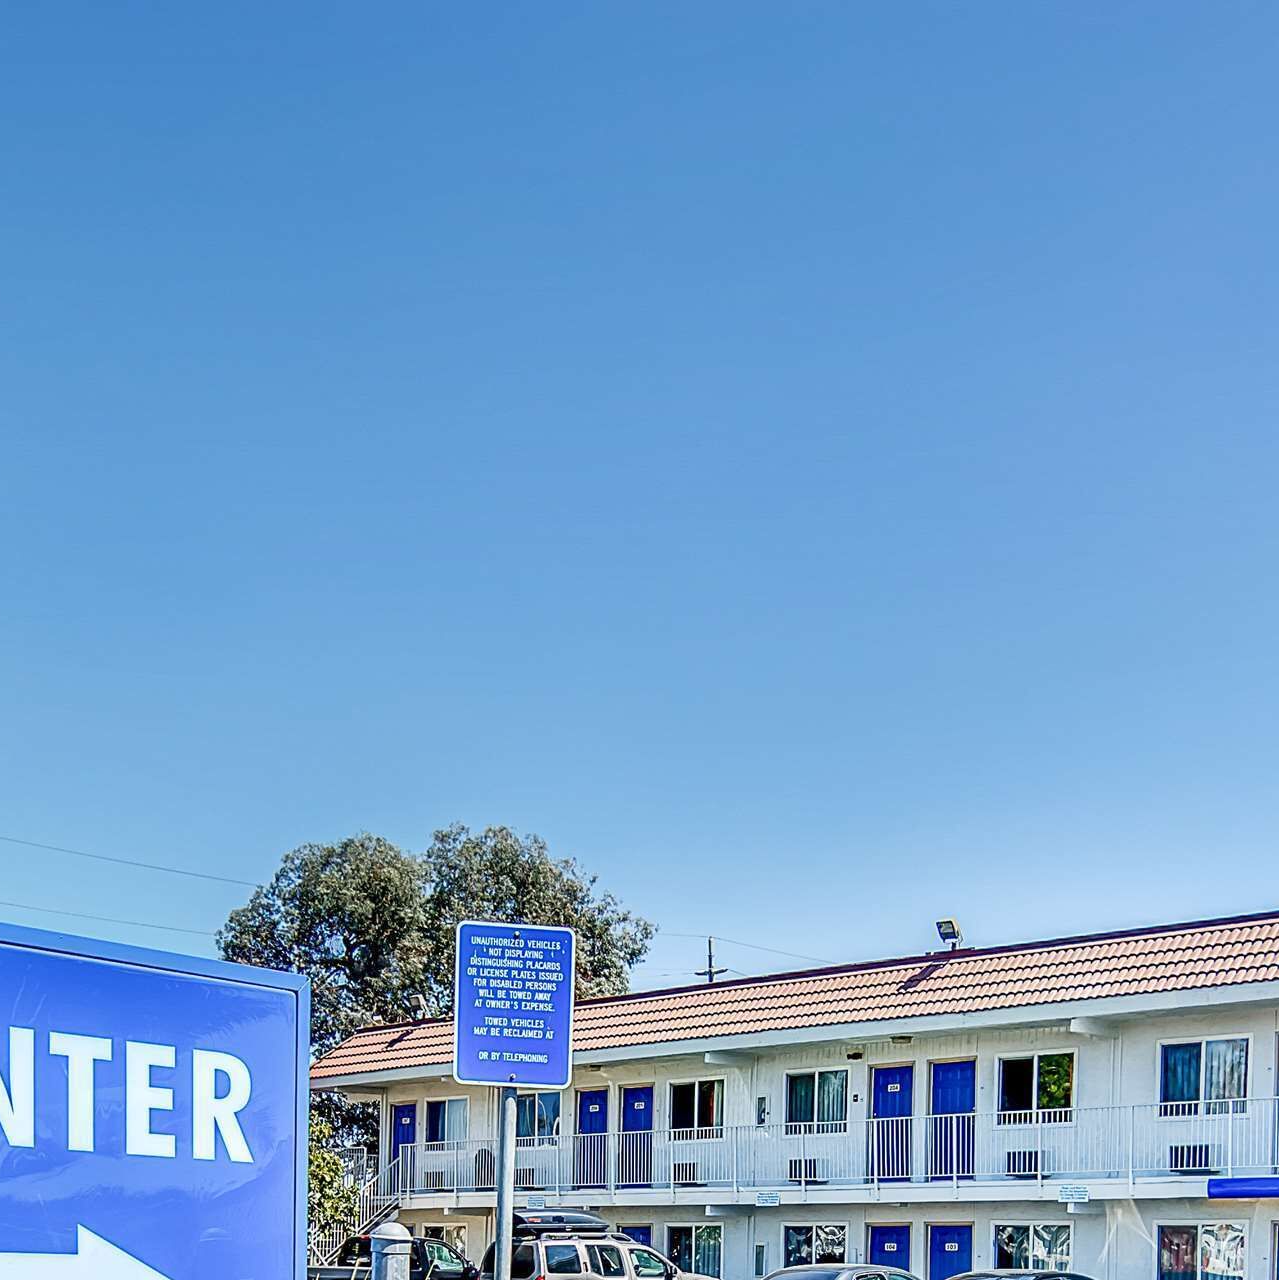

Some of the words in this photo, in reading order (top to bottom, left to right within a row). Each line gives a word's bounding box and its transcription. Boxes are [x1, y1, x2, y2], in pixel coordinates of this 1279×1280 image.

[471, 936, 524, 947] UNAUTHORIZED
[528, 940, 561, 950] VEHICLES
[489, 948, 502, 957] NOT
[505, 949, 544, 959] DISPLAYING
[470, 957, 523, 968] DISTINGUISHING
[526, 961, 561, 971] PLACARDS
[467, 967, 477, 976] OR
[480, 968, 509, 978] LICENSE
[512, 970, 536, 979] PLATES
[539, 972, 564, 981] ISSUED
[473, 978, 487, 986] FOR
[490, 979, 522, 989] DISABLED
[525, 981, 557, 991] PERSONS
[479, 989, 495, 998] WILL
[497, 989, 507, 998] BE
[510, 990, 532, 1000] TOWED
[534, 993, 552, 1001] AWAY
[474, 999, 483, 1008] AT
[485, 999, 519, 1010] OWNER'S
[521, 1002, 555, 1012] EXPENSE.
[484, 1016, 508, 1027] TOWED
[511, 1018, 544, 1029] VEHICLES
[473, 1026, 488, 1036] MAY
[490, 1027, 500, 1036] BE
[503, 1028, 543, 1039] RECLAIMED
[546, 1030, 554, 1039] AT
[478, 1051, 489, 1060] OR
[491, 1051, 501, 1061] BY
[503, 1052, 548, 1064] TELEPHONING
